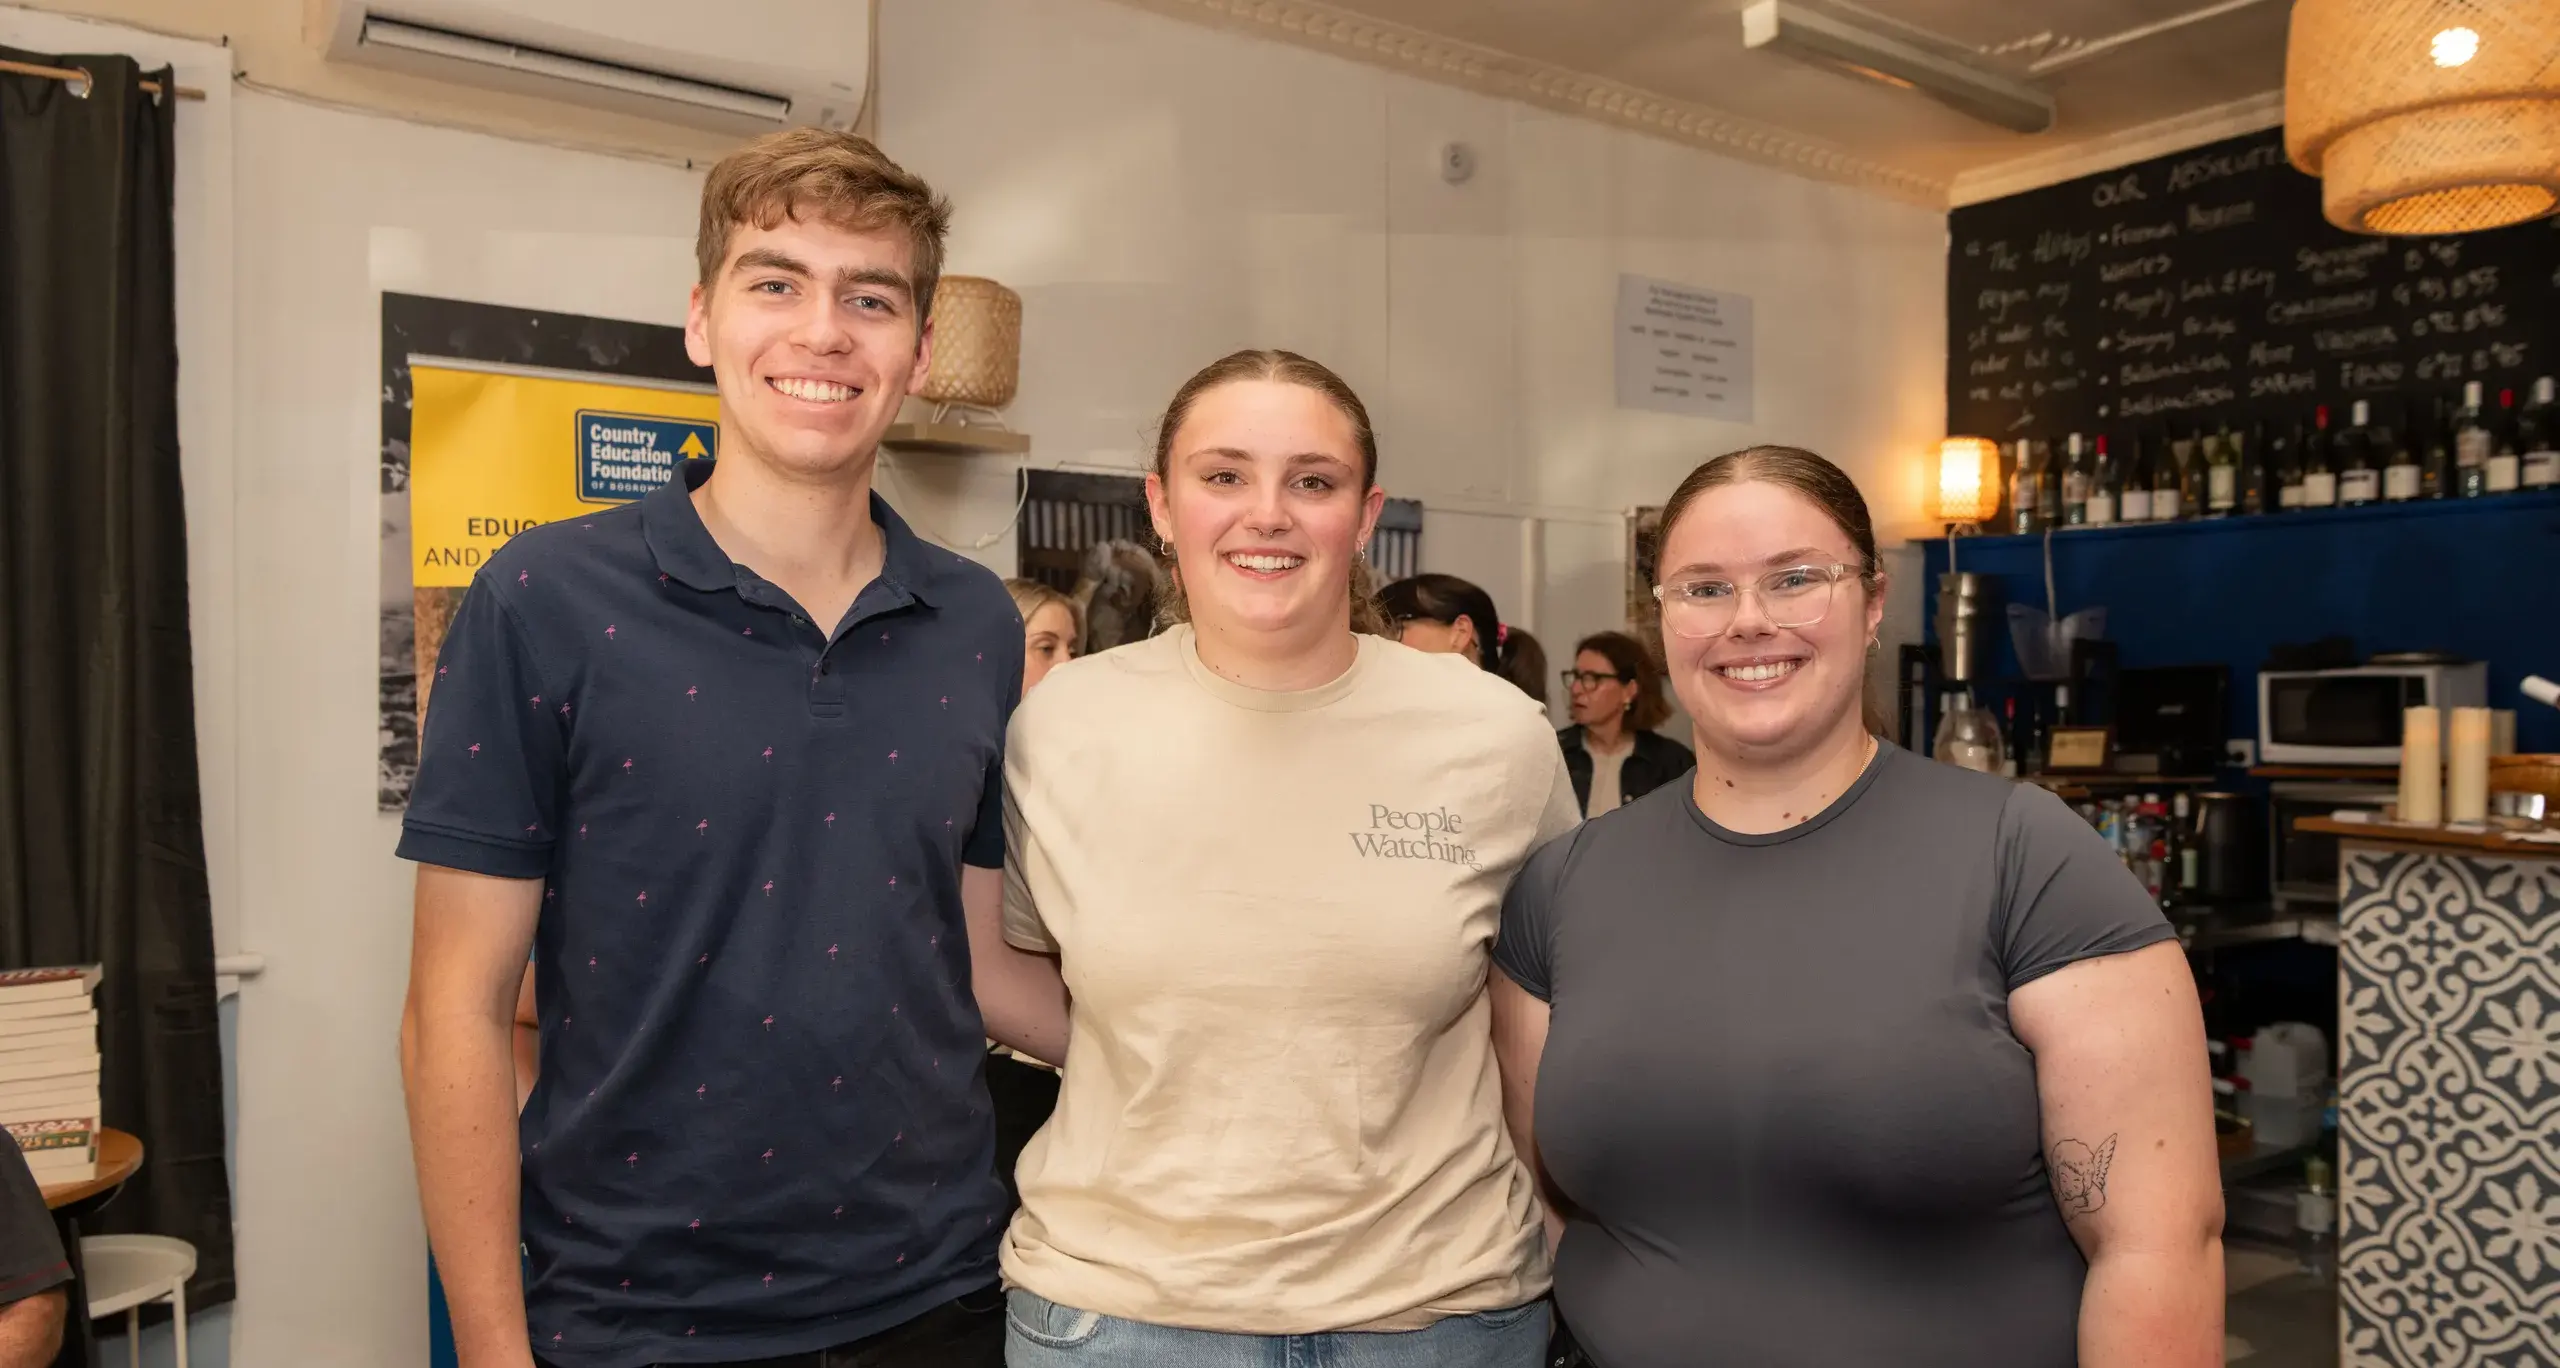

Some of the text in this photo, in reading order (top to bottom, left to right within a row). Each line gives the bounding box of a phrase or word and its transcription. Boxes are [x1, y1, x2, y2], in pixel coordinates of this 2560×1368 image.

[590, 422, 657, 447] Country
[591, 441, 673, 466] Education
[591, 460, 672, 484] Foundatio
[591, 480, 662, 493] OF BOOROW
[423, 546, 481, 567] AND
[1368, 803, 1463, 837] People
[1347, 832, 1484, 873] Watching
